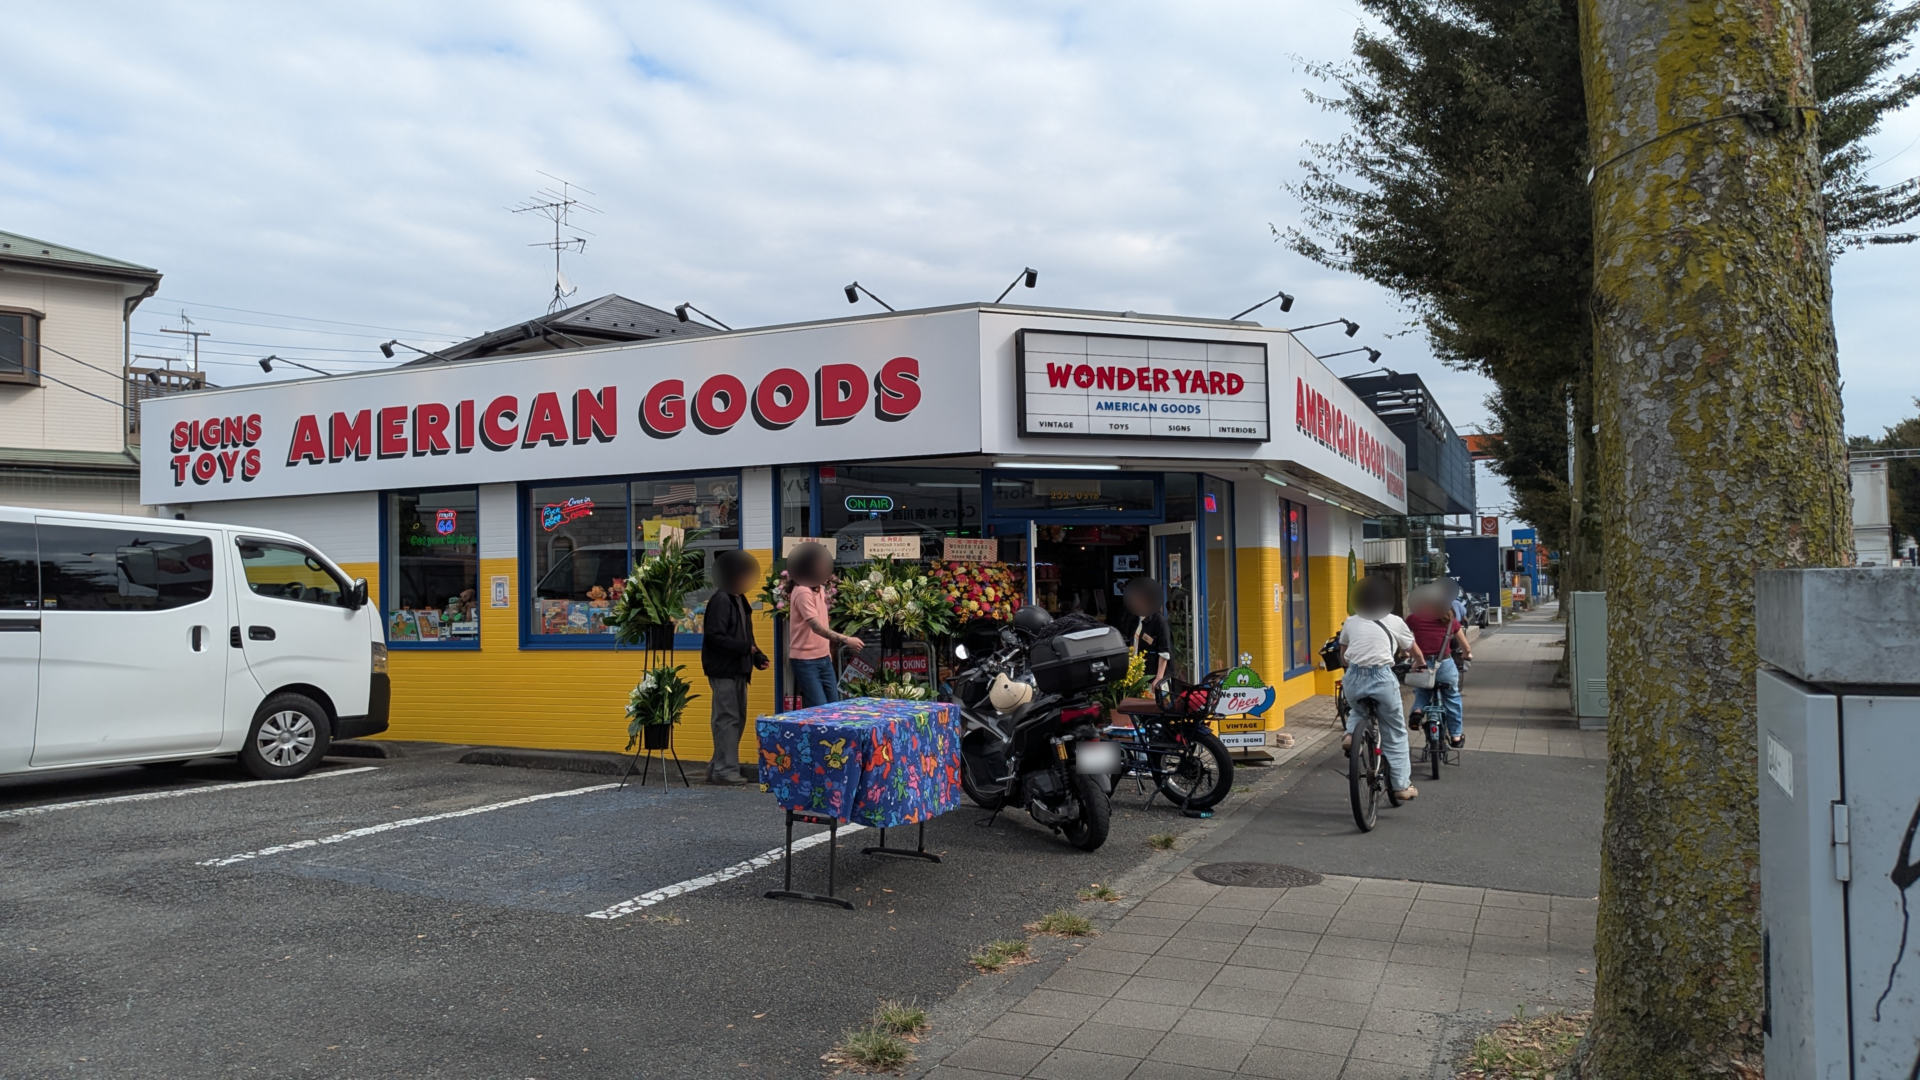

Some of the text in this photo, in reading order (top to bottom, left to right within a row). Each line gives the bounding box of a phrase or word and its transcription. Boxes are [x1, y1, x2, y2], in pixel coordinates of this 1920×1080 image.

[1046, 362, 1245, 395] WONDER YARD
[285, 356, 922, 467] AMERICAN GOODS
[1096, 401, 1201, 414] AMERICAN GOODS
[170, 413, 262, 452] SIGNS
[1039, 421, 1074, 429] VINTAGE
[1218, 426, 1257, 434] INTERIORS
[1296, 376, 1357, 466] AMERICAN
[1358, 426, 1385, 483] GOODS
[170, 448, 261, 487] TOYS
[848, 498, 889, 509] ON AIR
[438, 520, 453, 532] 66
[852, 657, 875, 675] STOP
[1227, 697, 1259, 711] Open
